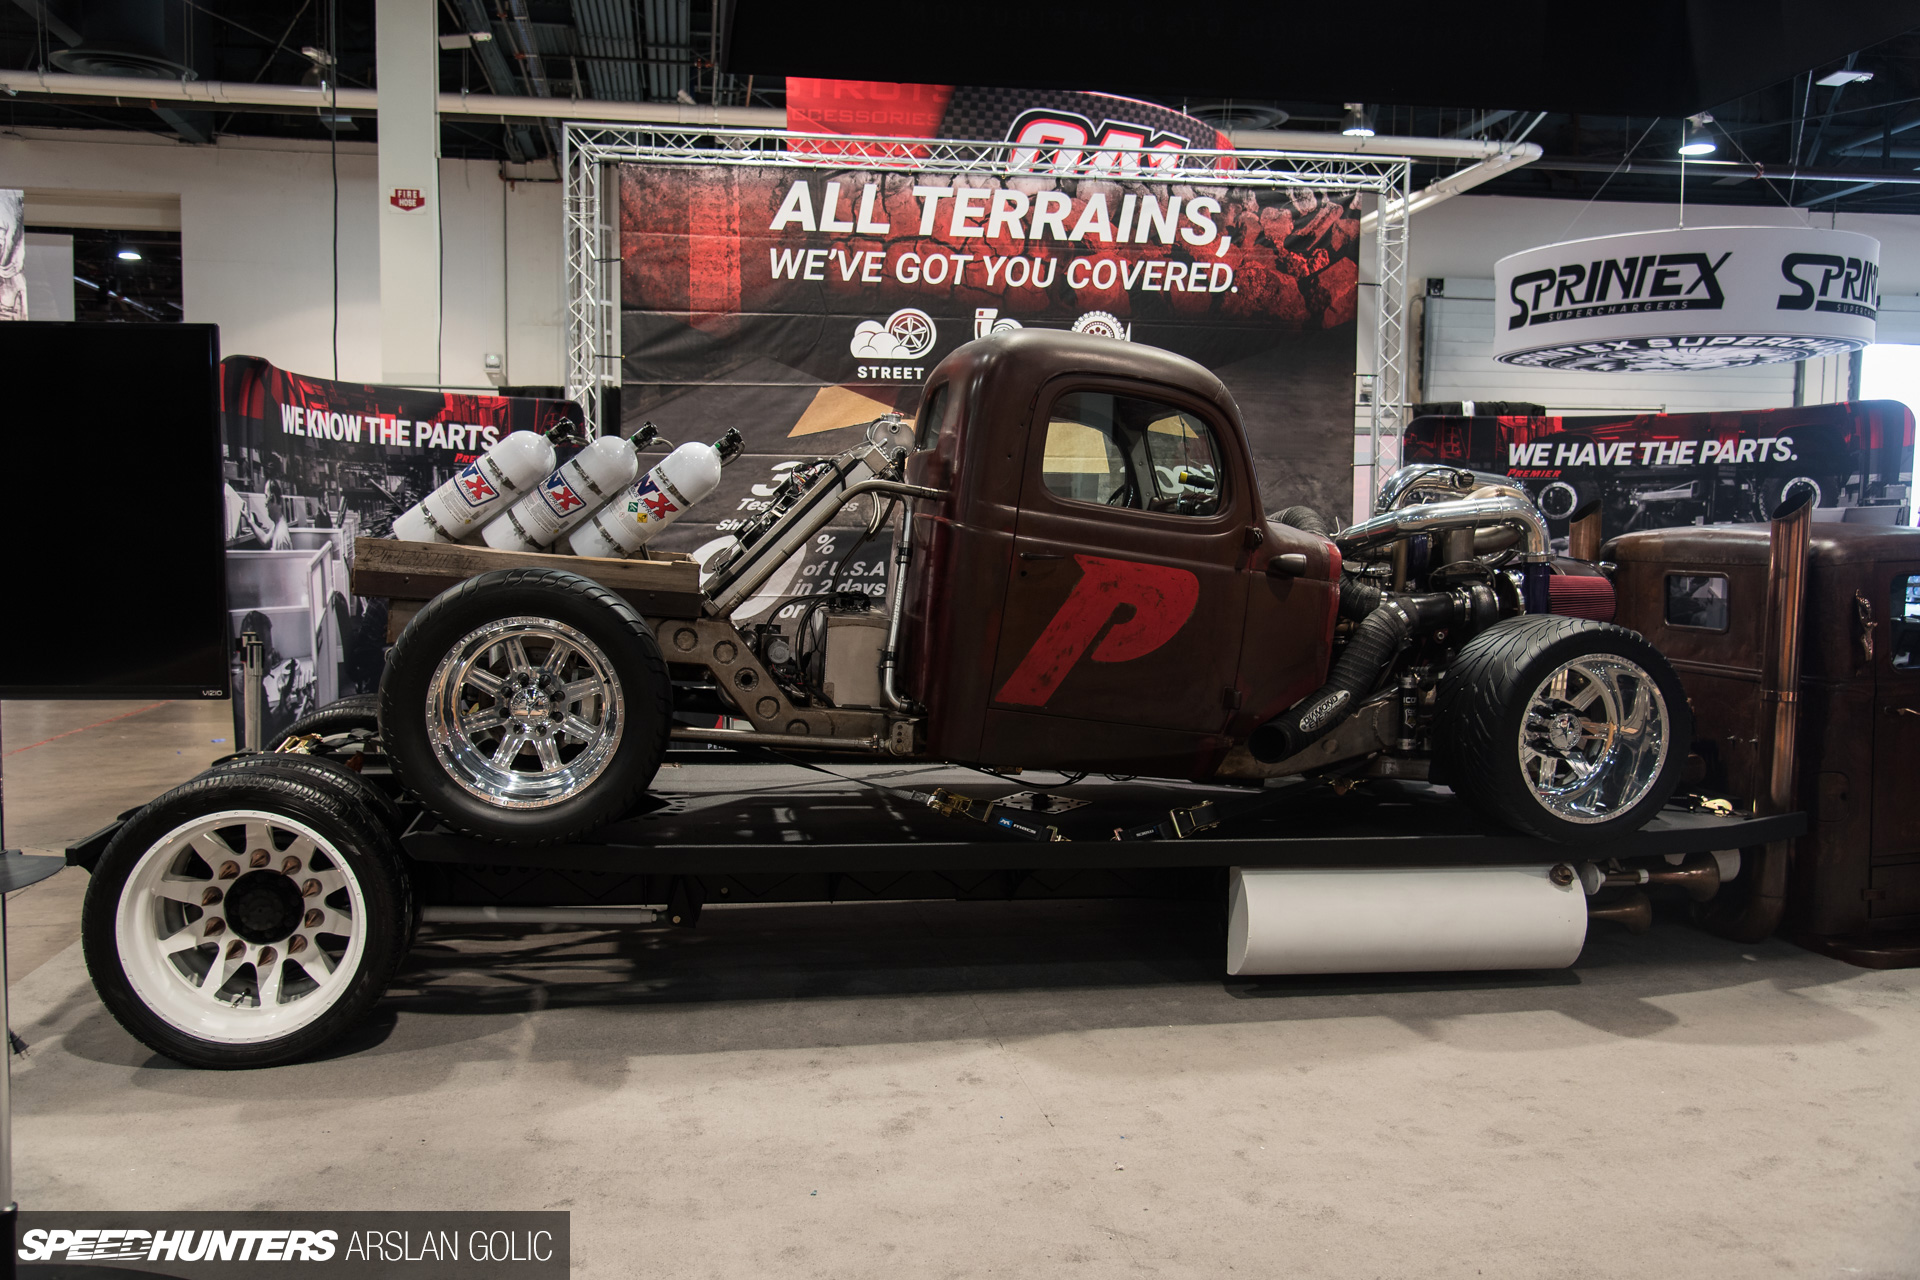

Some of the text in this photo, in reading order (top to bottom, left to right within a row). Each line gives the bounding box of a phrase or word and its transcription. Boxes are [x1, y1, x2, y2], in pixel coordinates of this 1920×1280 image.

[397, 190, 417, 198] FIRE
[399, 199, 417, 207] HOSE
[769, 180, 1232, 258] ALL TERRAINS,
[769, 248, 1238, 293] WE'VE GOT YOU COVERED.
[1508, 252, 1733, 331] SPRINTEX
[1548, 301, 1689, 321] SUPERCHARGERS
[857, 366, 924, 379] STREET
[281, 403, 304, 436] WE
[306, 409, 361, 443] KNOW
[365, 417, 411, 447] THE
[1508, 437, 1798, 466] WE HAVE THE PARTS.
[1507, 468, 1561, 478] PREMIER
[544, 470, 582, 511] NX
[634, 473, 679, 519] NX
[637, 498, 660, 522] EXPRESS
[364, 545, 482, 570] PREMIER
[803, 561, 828, 576] of
[791, 579, 813, 595] in
[816, 579, 833, 594] 2
[995, 554, 1200, 706] P
[1303, 695, 1338, 724] DIAMOND
